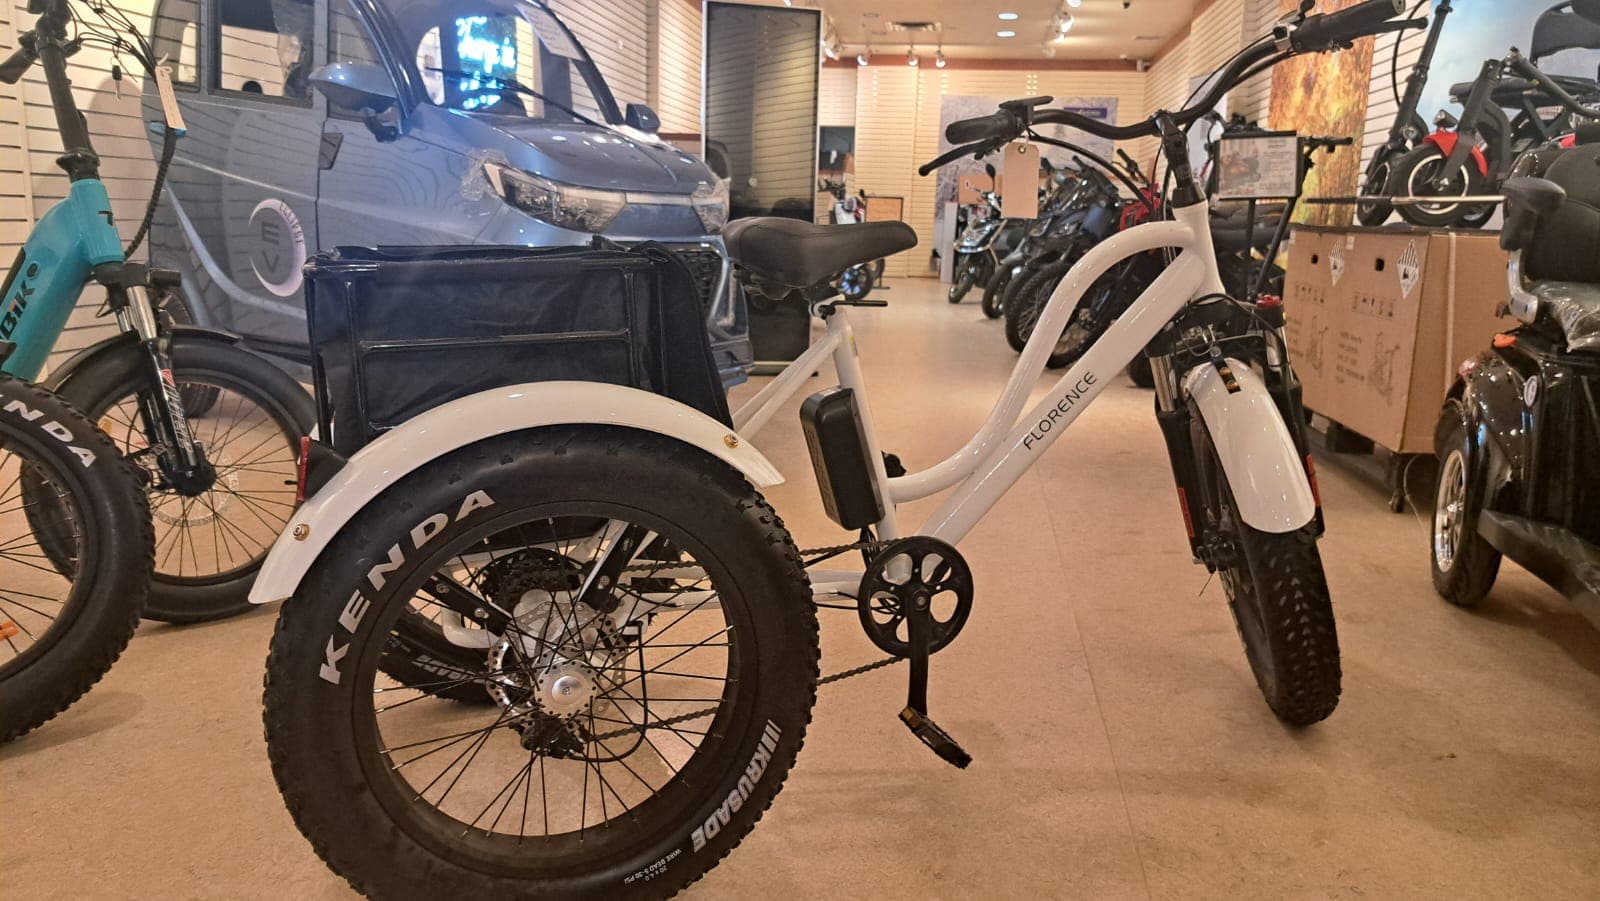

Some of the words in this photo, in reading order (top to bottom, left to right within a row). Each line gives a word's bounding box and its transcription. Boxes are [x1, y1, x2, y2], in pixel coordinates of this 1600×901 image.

[0, 394, 96, 468] NDA
[1023, 371, 1097, 450] FLORENCE
[319, 489, 496, 685] KENDA
[690, 741, 773, 854] KRUSADE
[623, 875, 635, 885] PSI
[648, 858, 666, 872] BEAD
[665, 848, 682, 863] WIRE
